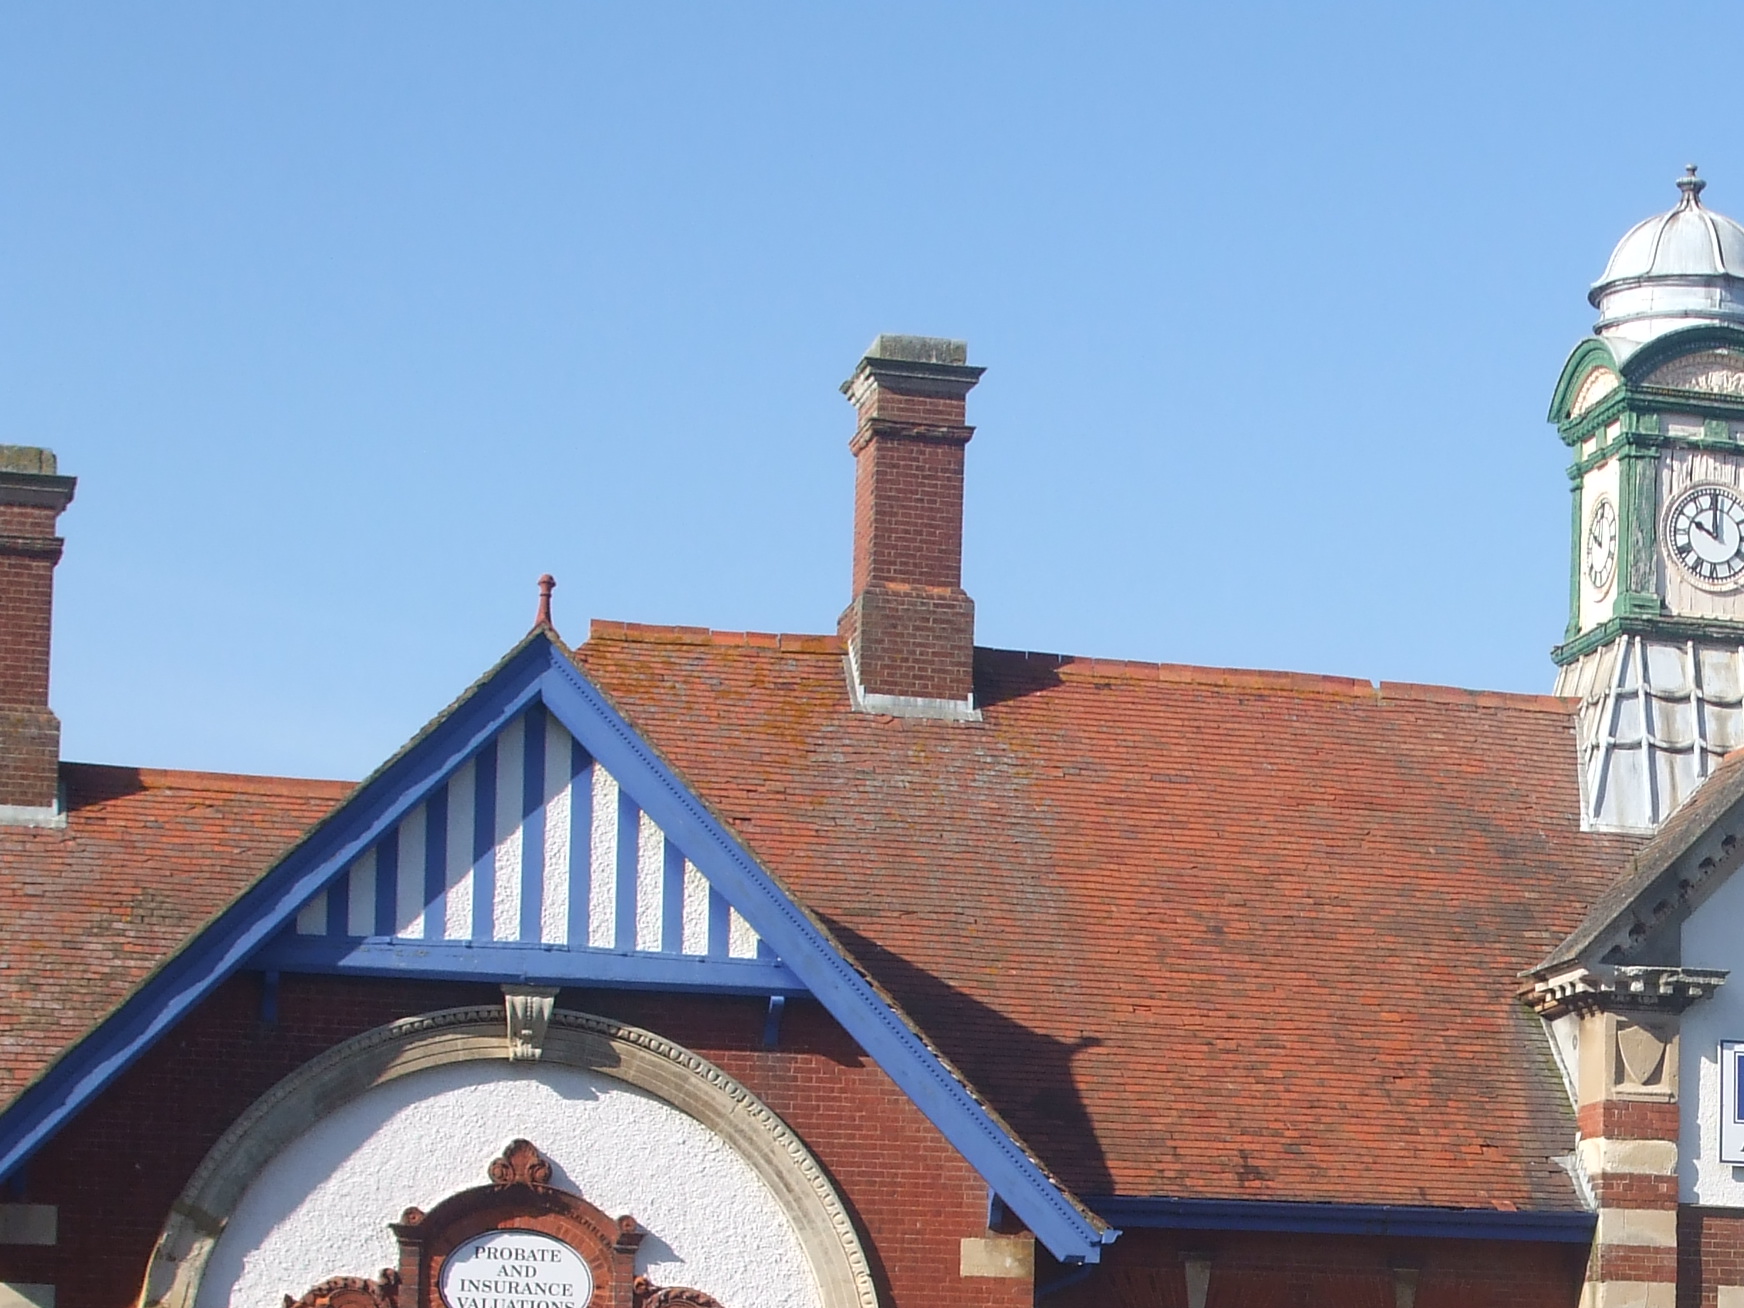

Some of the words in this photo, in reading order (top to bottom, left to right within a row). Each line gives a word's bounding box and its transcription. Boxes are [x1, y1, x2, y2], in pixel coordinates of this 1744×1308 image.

[475, 1246, 561, 1262] PROBATE
[498, 1265, 536, 1278] AND
[461, 1279, 573, 1297] INSURANCE
